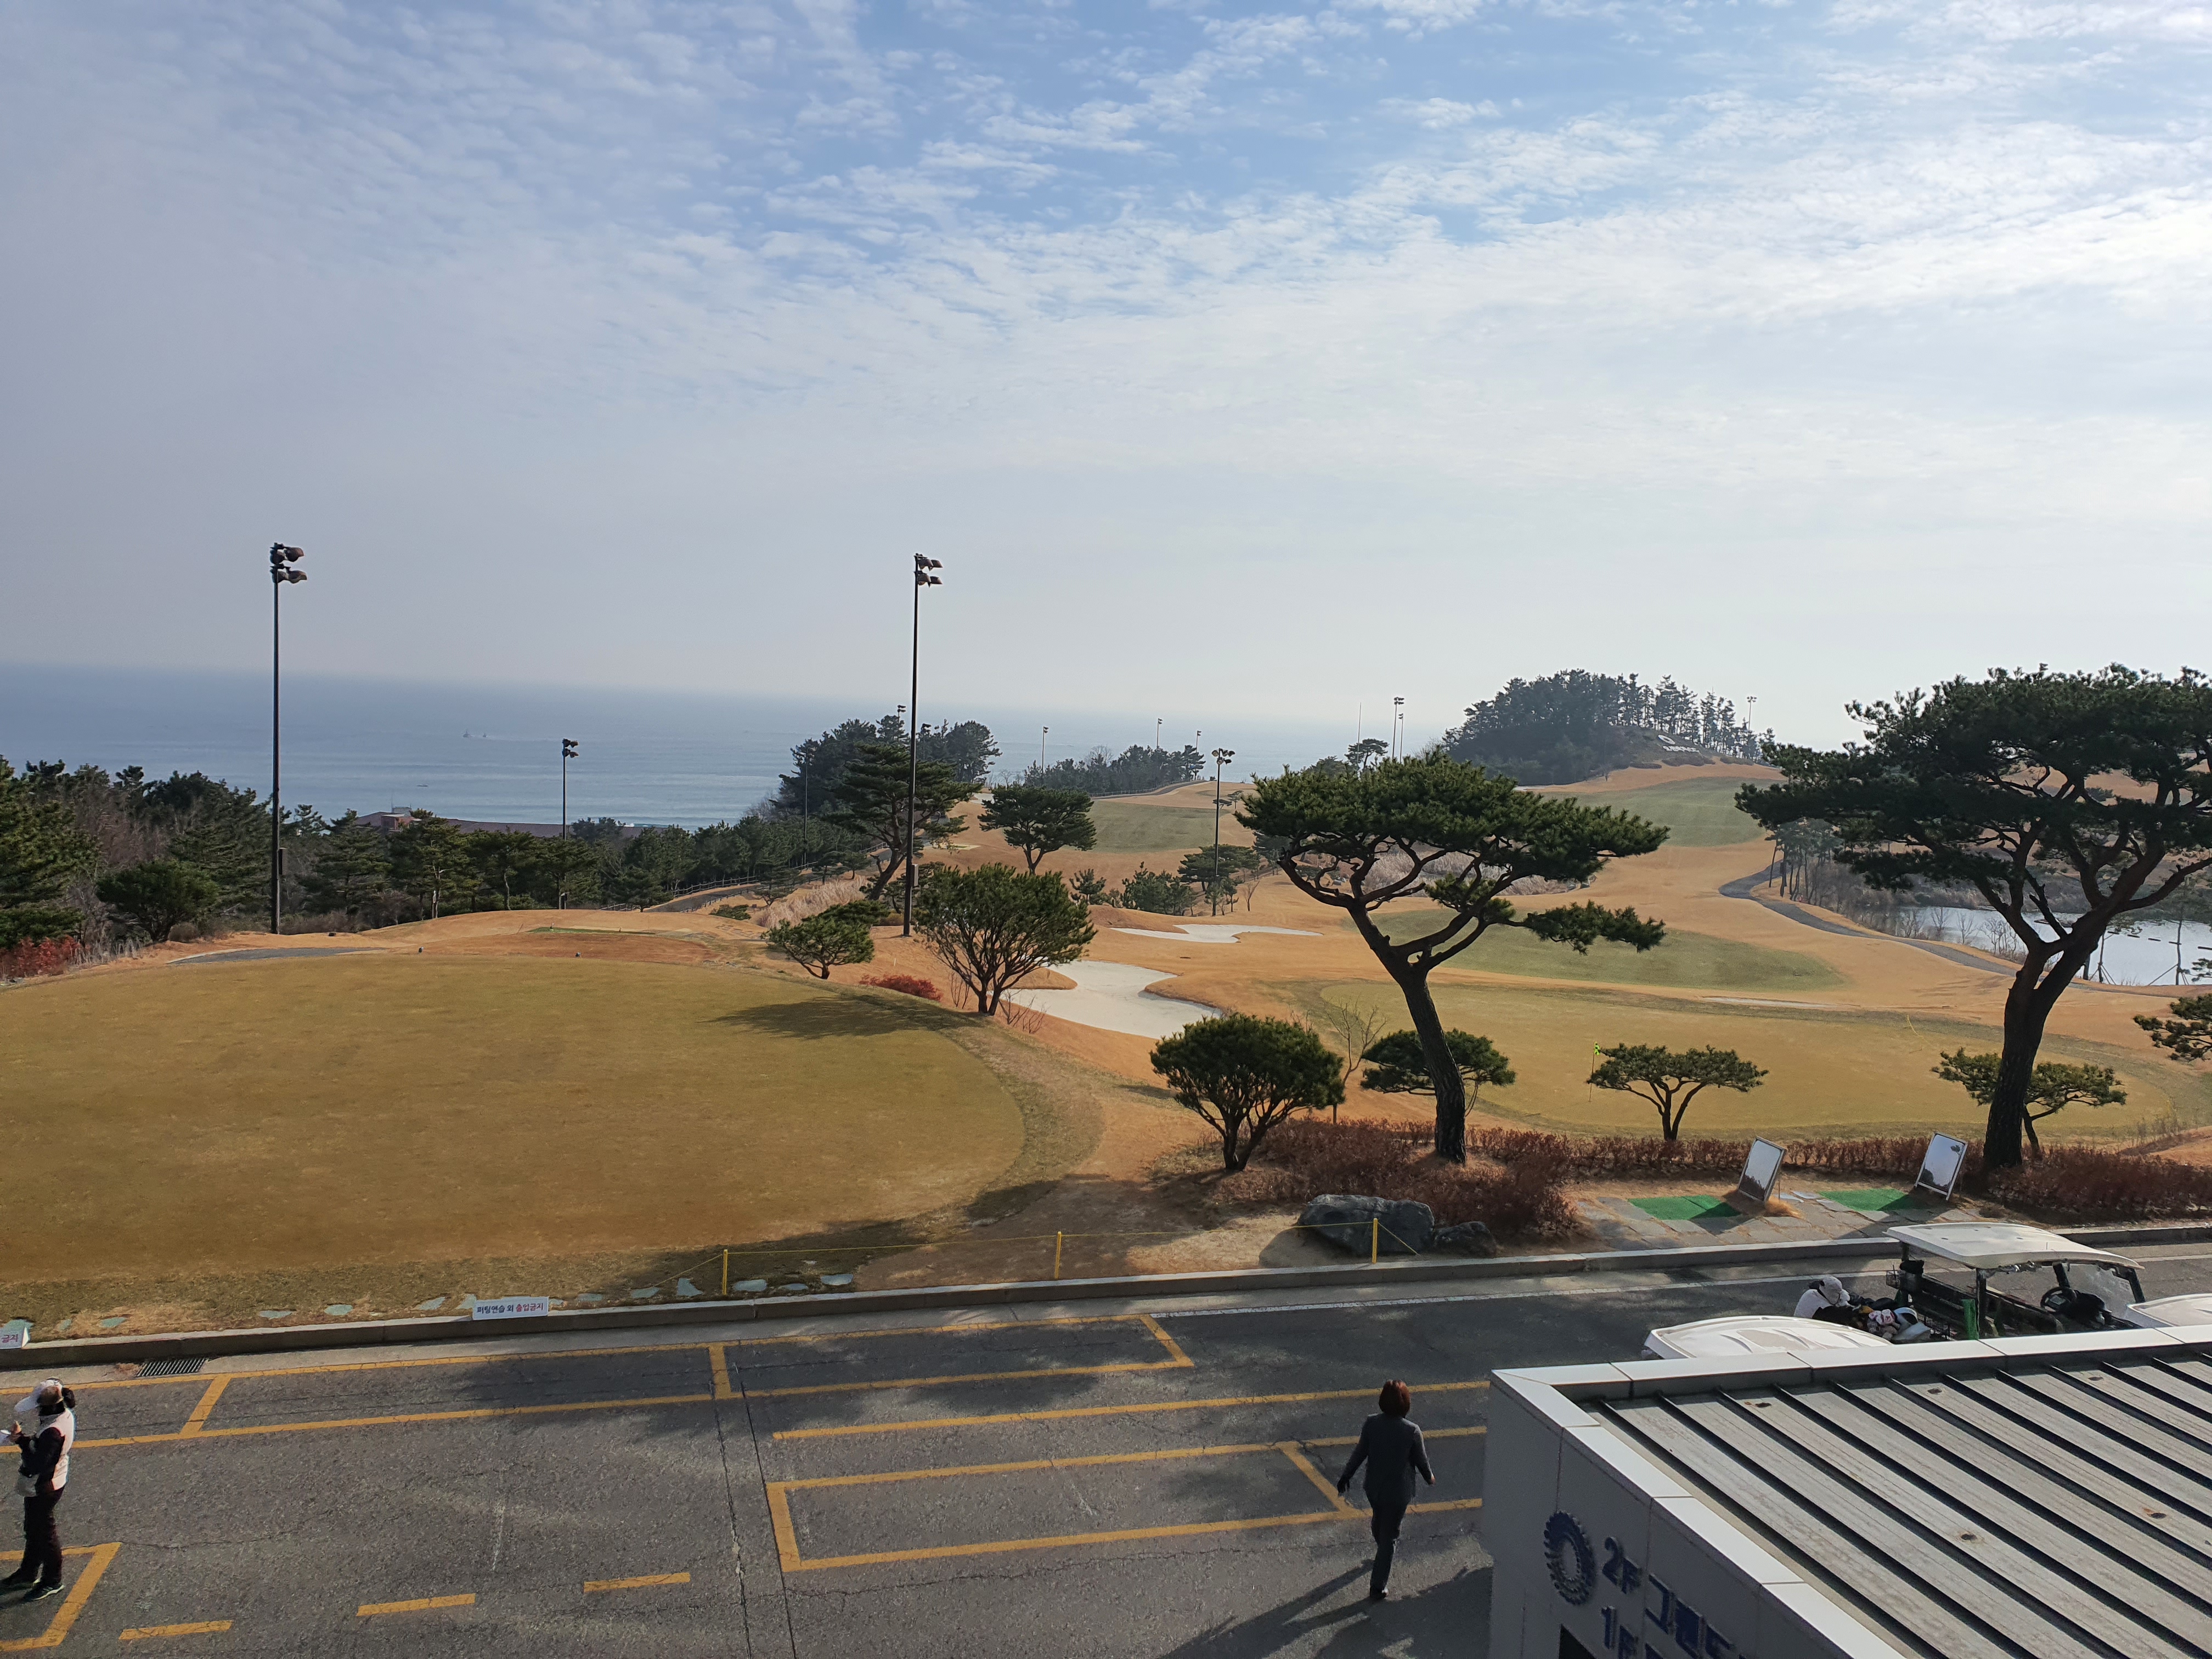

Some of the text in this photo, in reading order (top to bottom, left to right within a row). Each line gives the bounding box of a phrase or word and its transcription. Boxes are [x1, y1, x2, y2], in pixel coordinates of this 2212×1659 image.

[477, 1305, 505, 1314] 퍼팅연습
[515, 1302, 544, 1312] 출입금지
[1, 1334, 18, 1343] 금지
